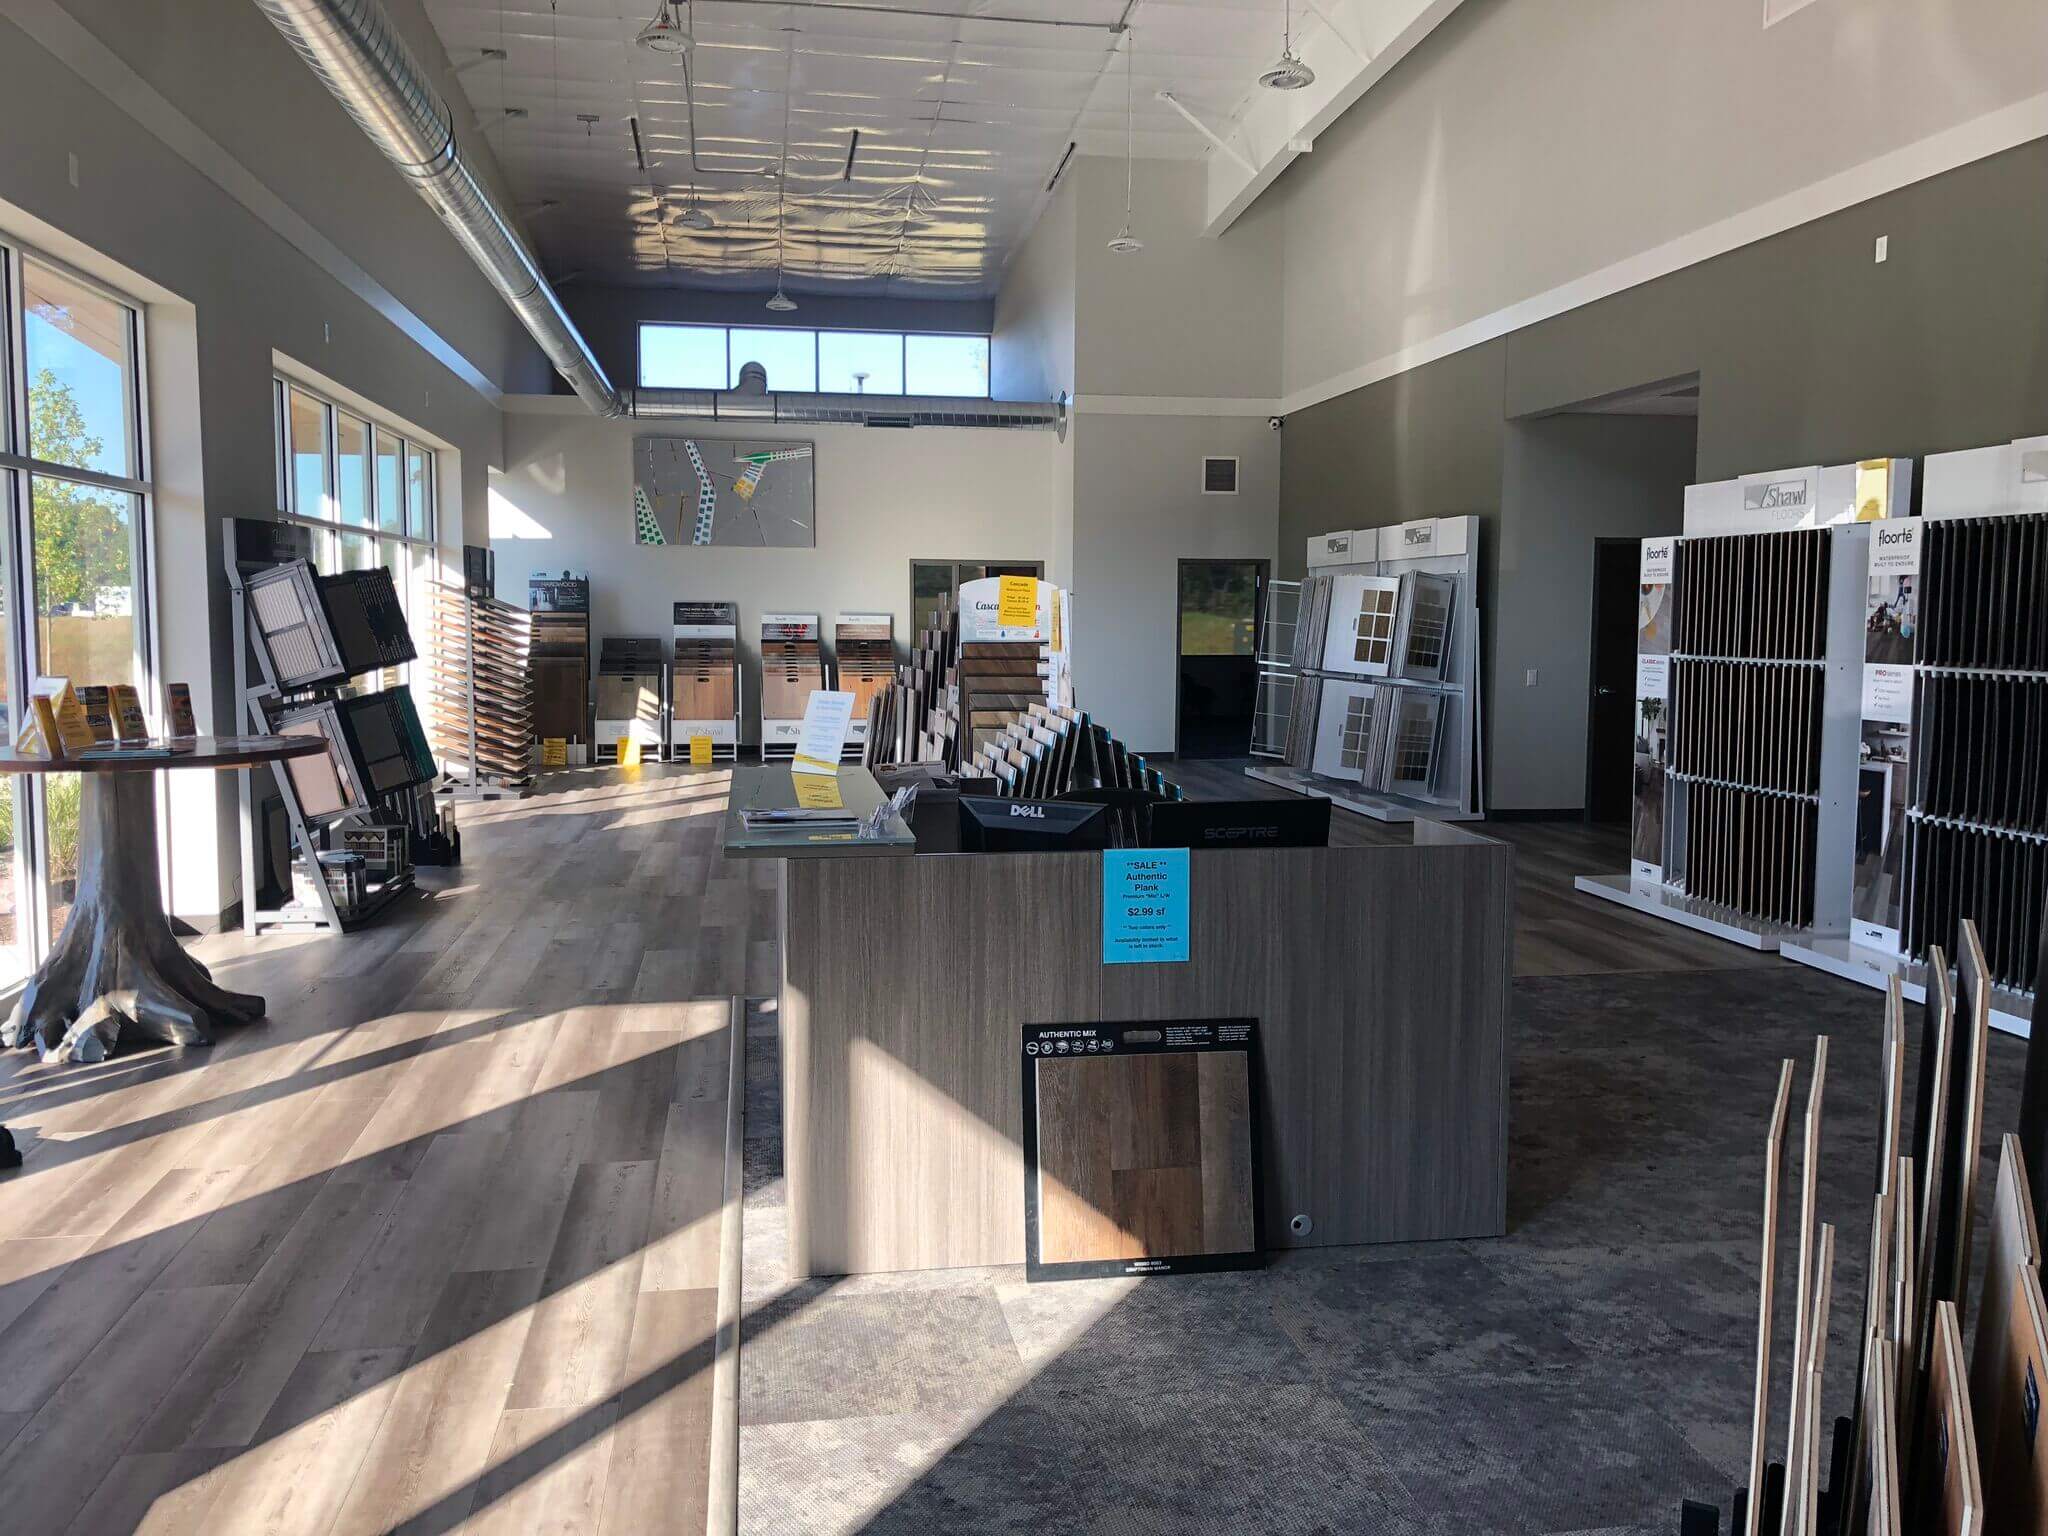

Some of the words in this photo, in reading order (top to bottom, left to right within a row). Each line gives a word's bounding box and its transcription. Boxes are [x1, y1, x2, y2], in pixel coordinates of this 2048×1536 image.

[1769, 486, 1804, 507] Shaw
[975, 600, 1000, 611] Casca
[790, 727, 800, 735] Sh
[1010, 804, 1045, 818] DELL
[1204, 826, 1280, 840] SCEPTRE
[1126, 872, 1167, 881] Authentic
[1135, 883, 1159, 891] Plank
[1127, 907, 1154, 917] $2.99
[1156, 907, 1165, 916] sf
[1039, 1030, 1082, 1039] AUTHENTIC
